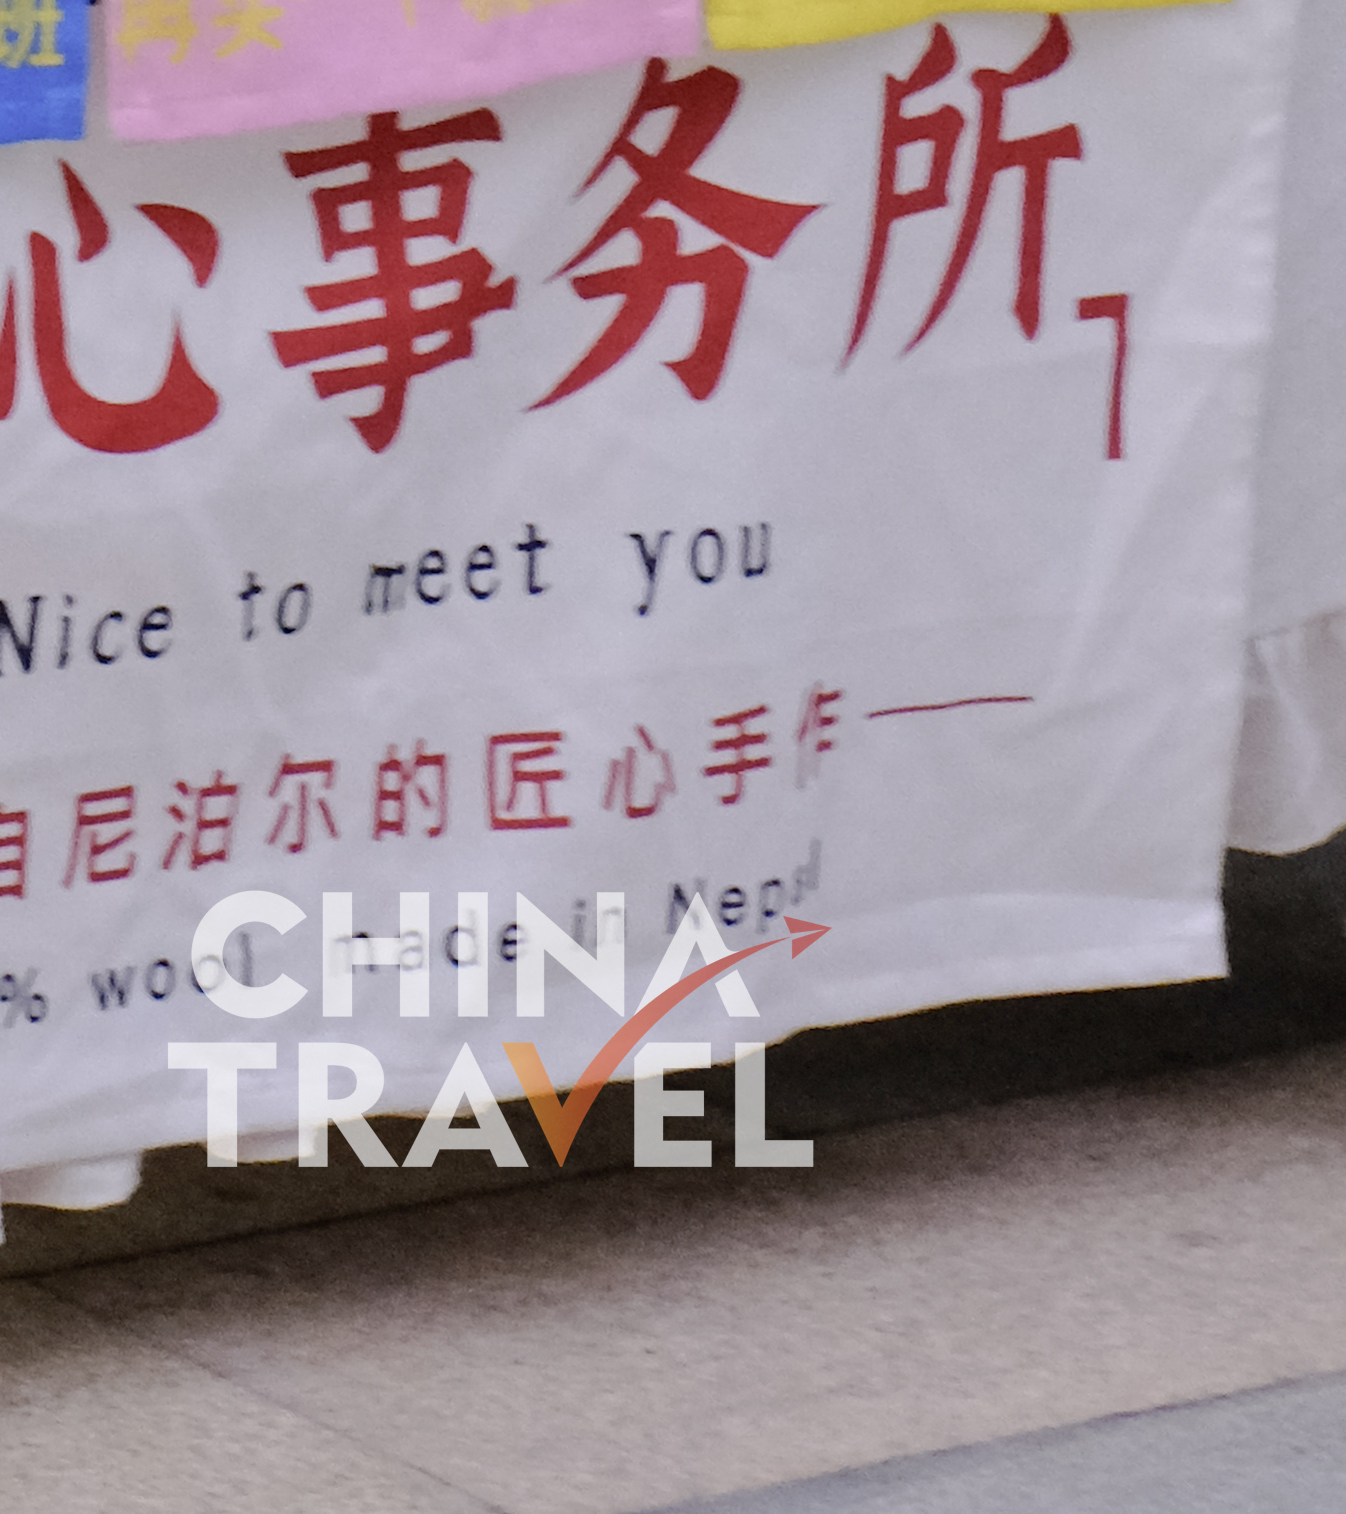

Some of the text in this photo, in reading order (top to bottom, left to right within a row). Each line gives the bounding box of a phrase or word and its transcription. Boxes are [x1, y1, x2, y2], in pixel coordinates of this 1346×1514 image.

[237, 571, 311, 640] to
[362, 524, 553, 613] meet
[628, 519, 771, 615] you
[92, 933, 255, 1013] wool
